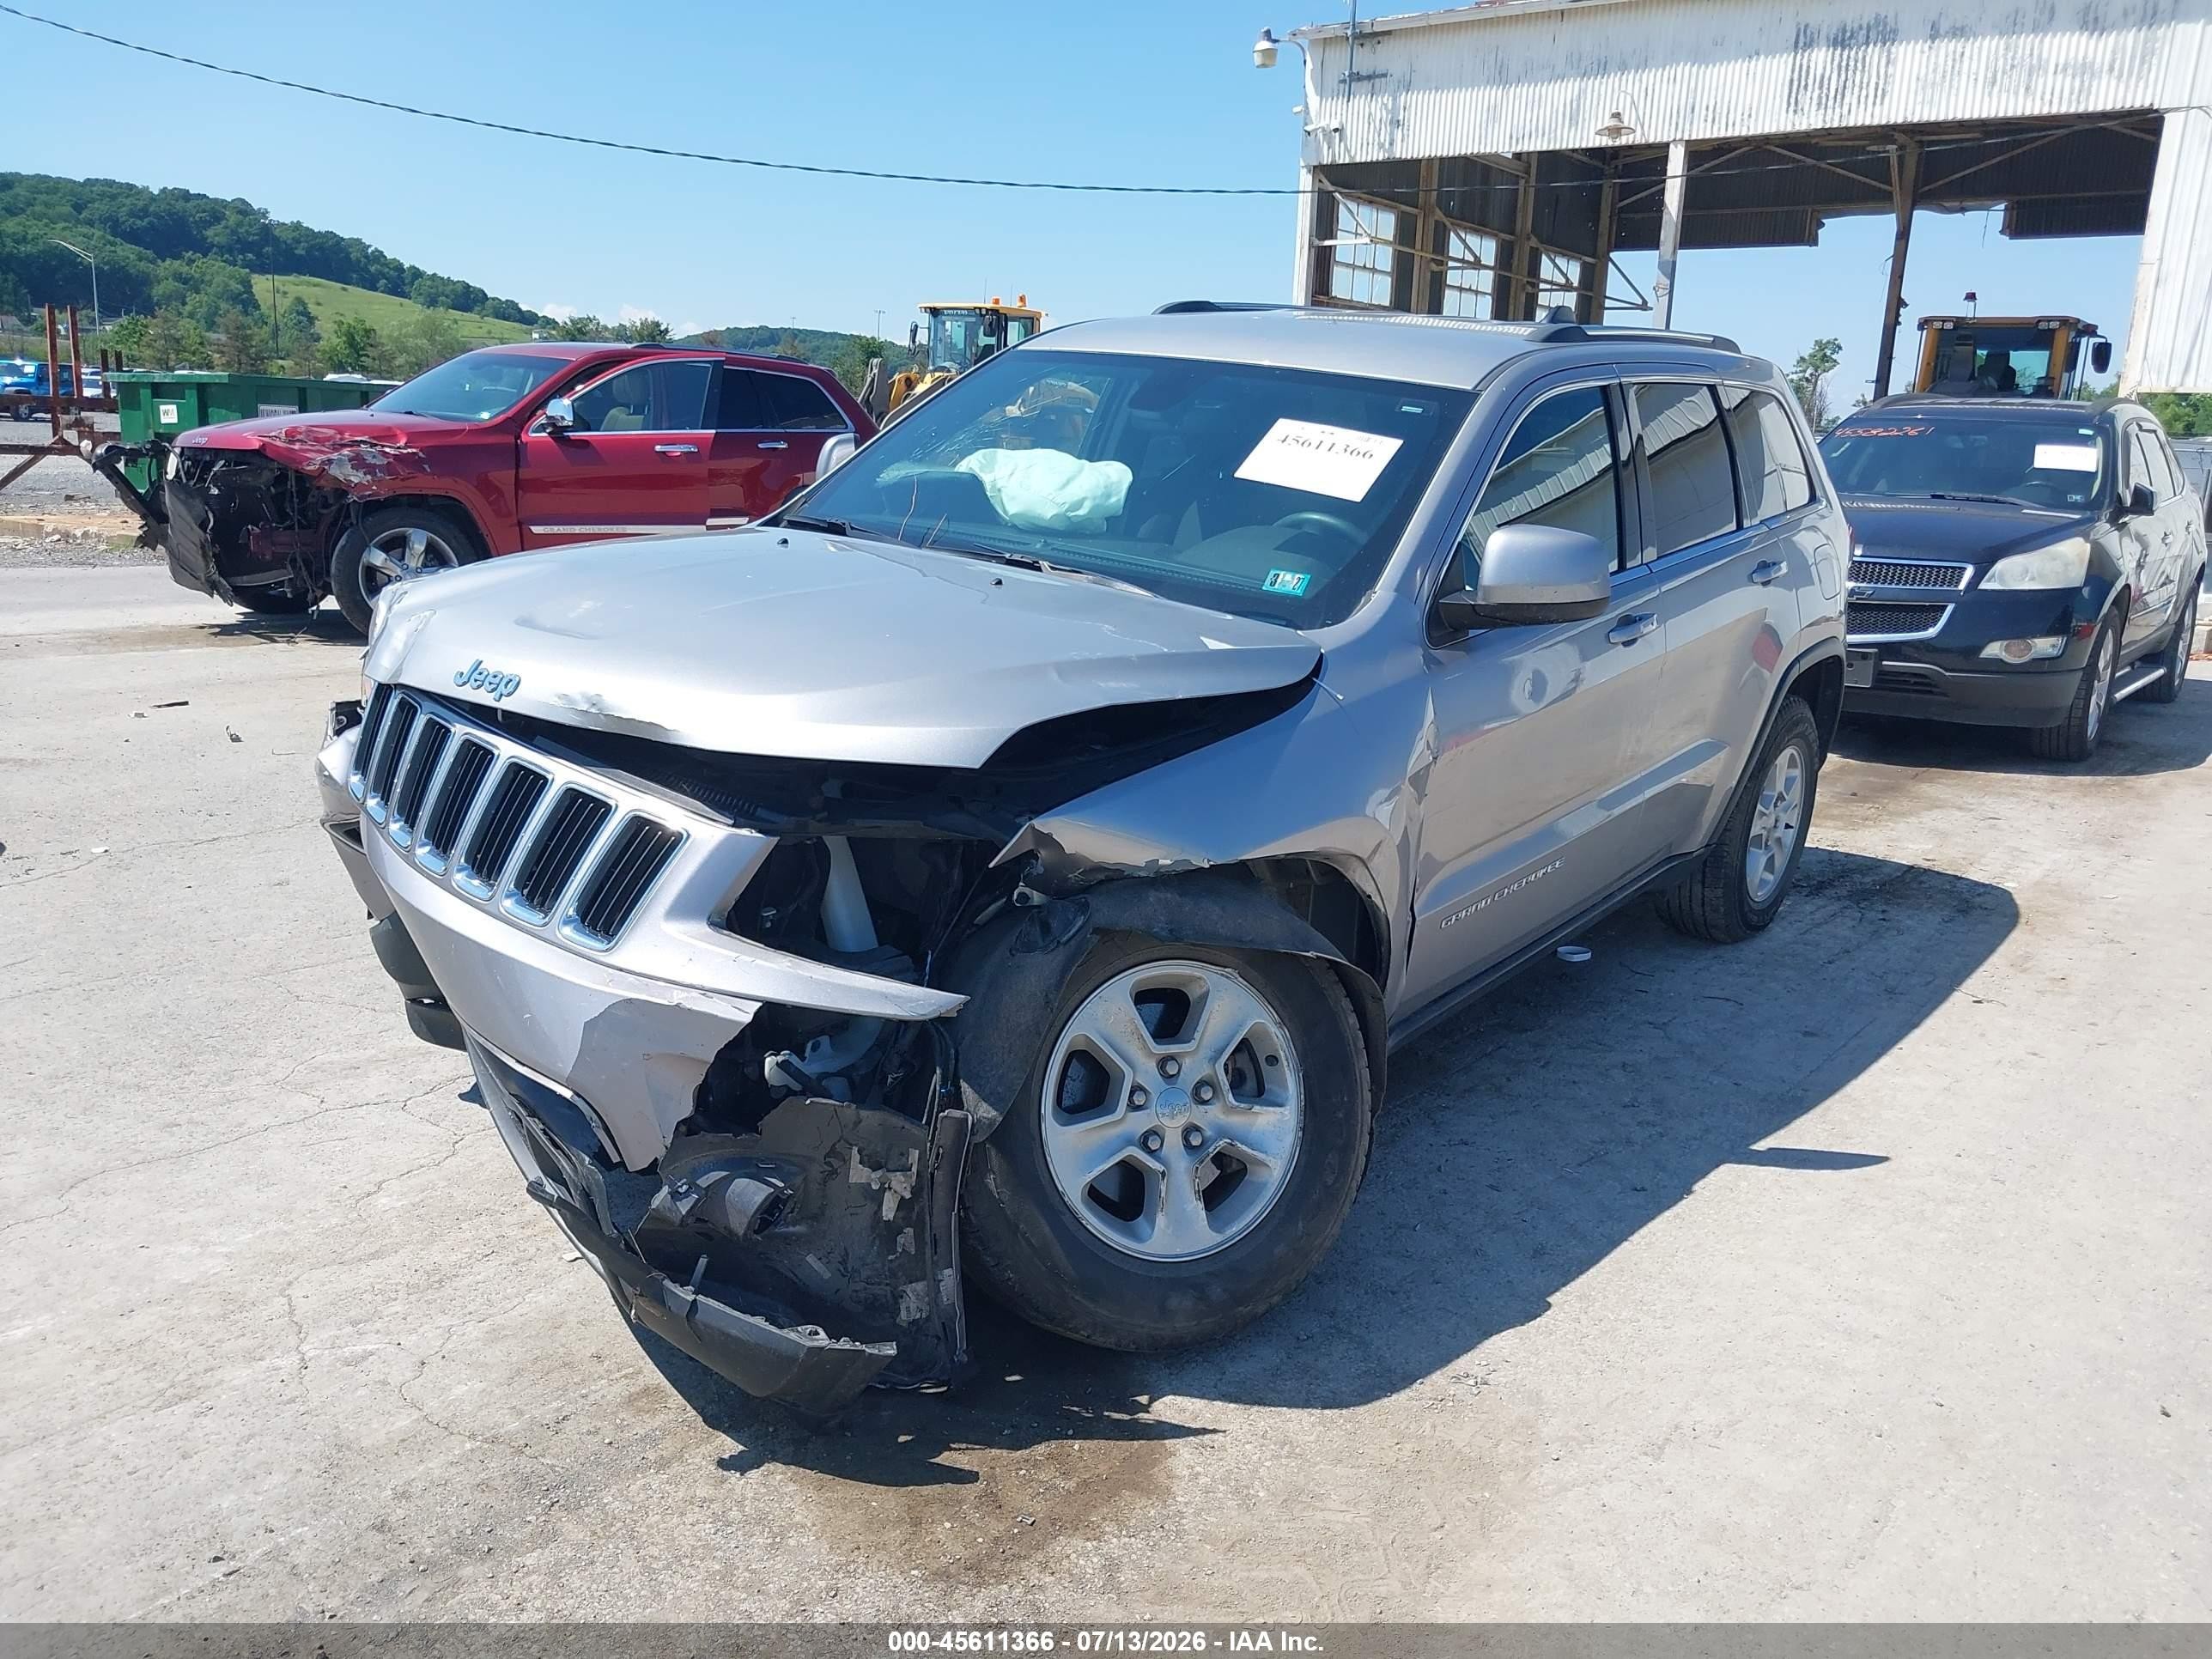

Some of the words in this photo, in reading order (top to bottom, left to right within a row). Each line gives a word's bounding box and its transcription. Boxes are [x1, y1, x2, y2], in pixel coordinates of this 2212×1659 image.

[1277, 434, 1374, 459] 45611366
[1269, 573, 1279, 587] 3
[453, 659, 521, 702] Jeep
[1440, 896, 1492, 929] GRAND
[1493, 857, 1565, 902] CHEROKEE
